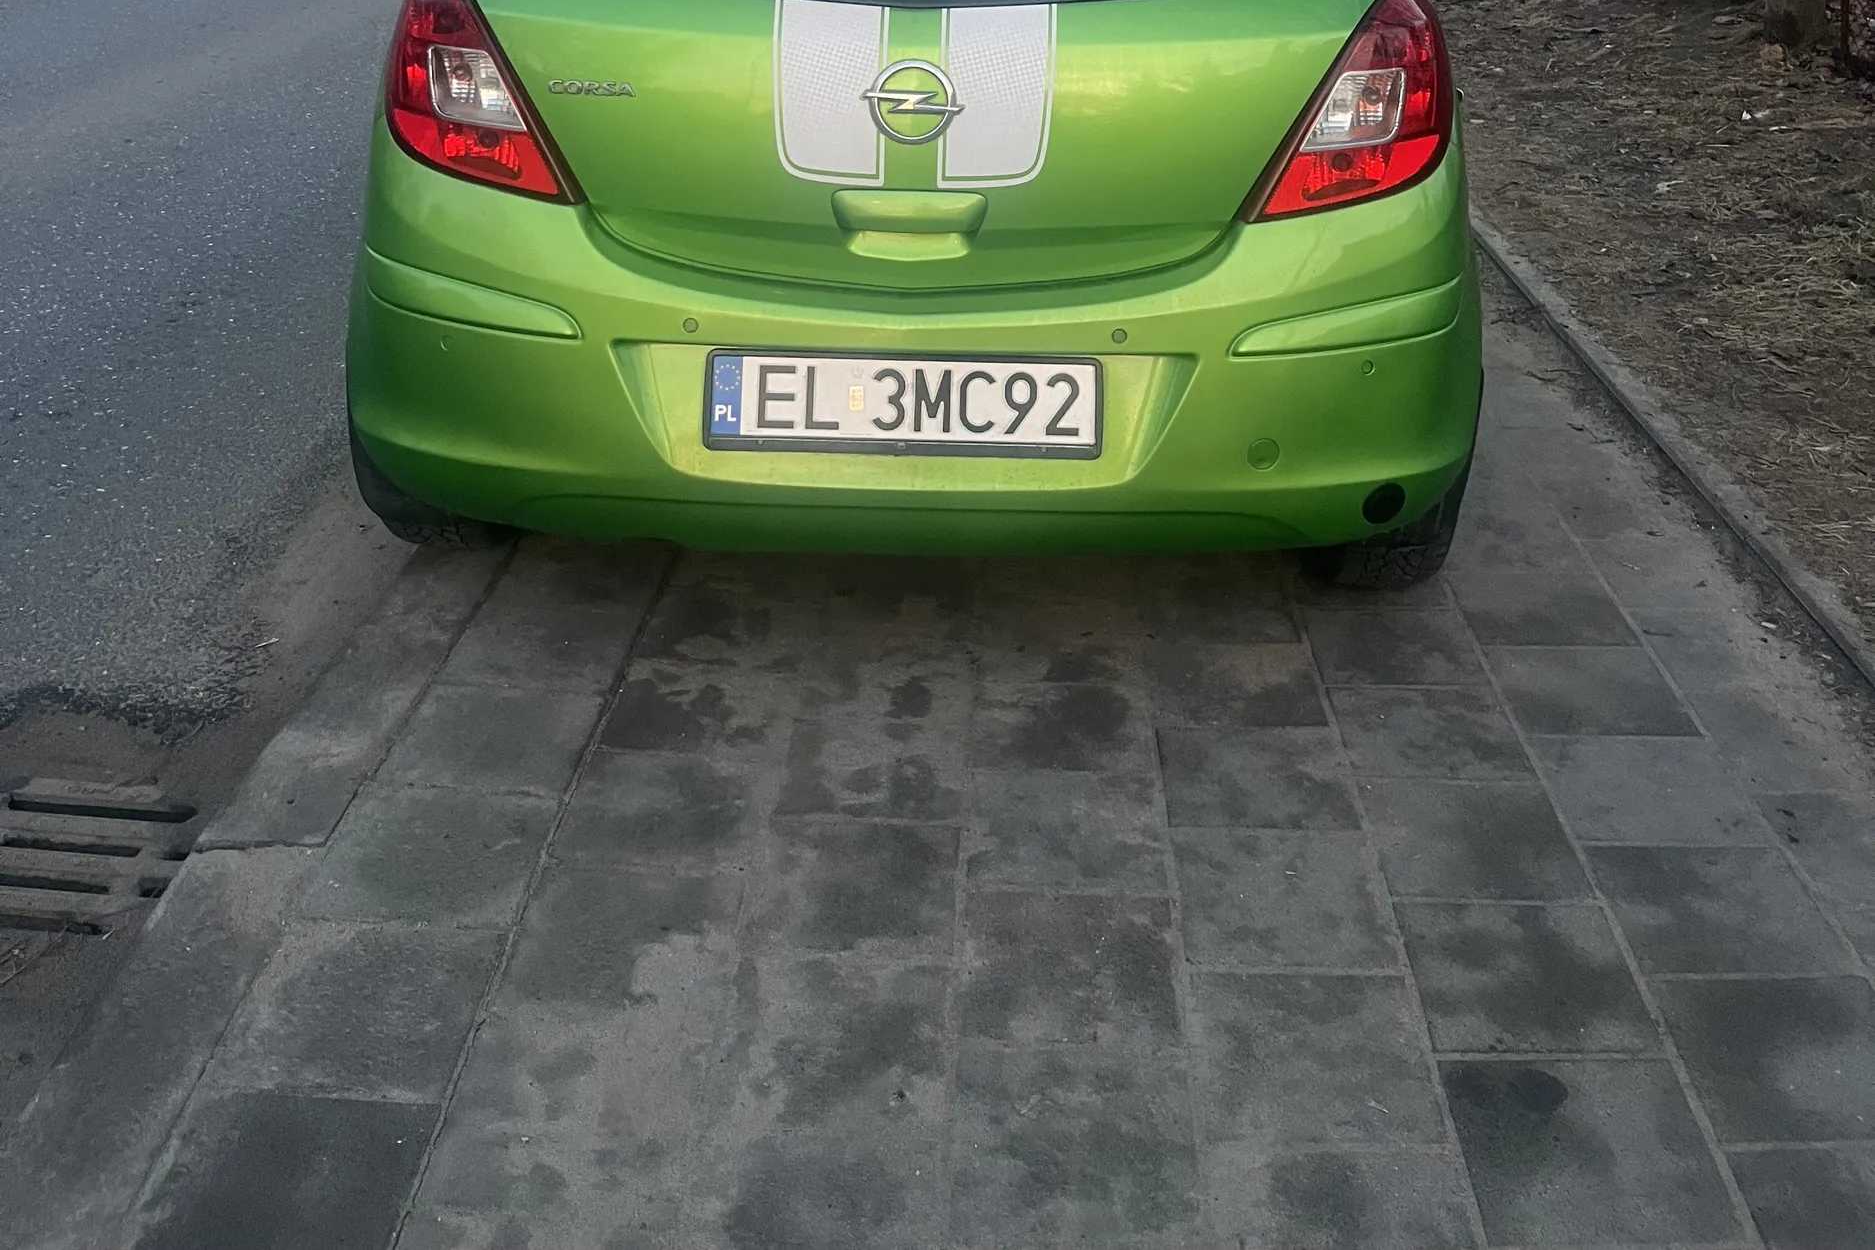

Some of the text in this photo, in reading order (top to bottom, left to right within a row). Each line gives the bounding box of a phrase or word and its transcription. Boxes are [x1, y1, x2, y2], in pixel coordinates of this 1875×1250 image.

[548, 79, 636, 97] CORSA
[757, 364, 1080, 437] EL 3MC92
[714, 405, 737, 422] PL
